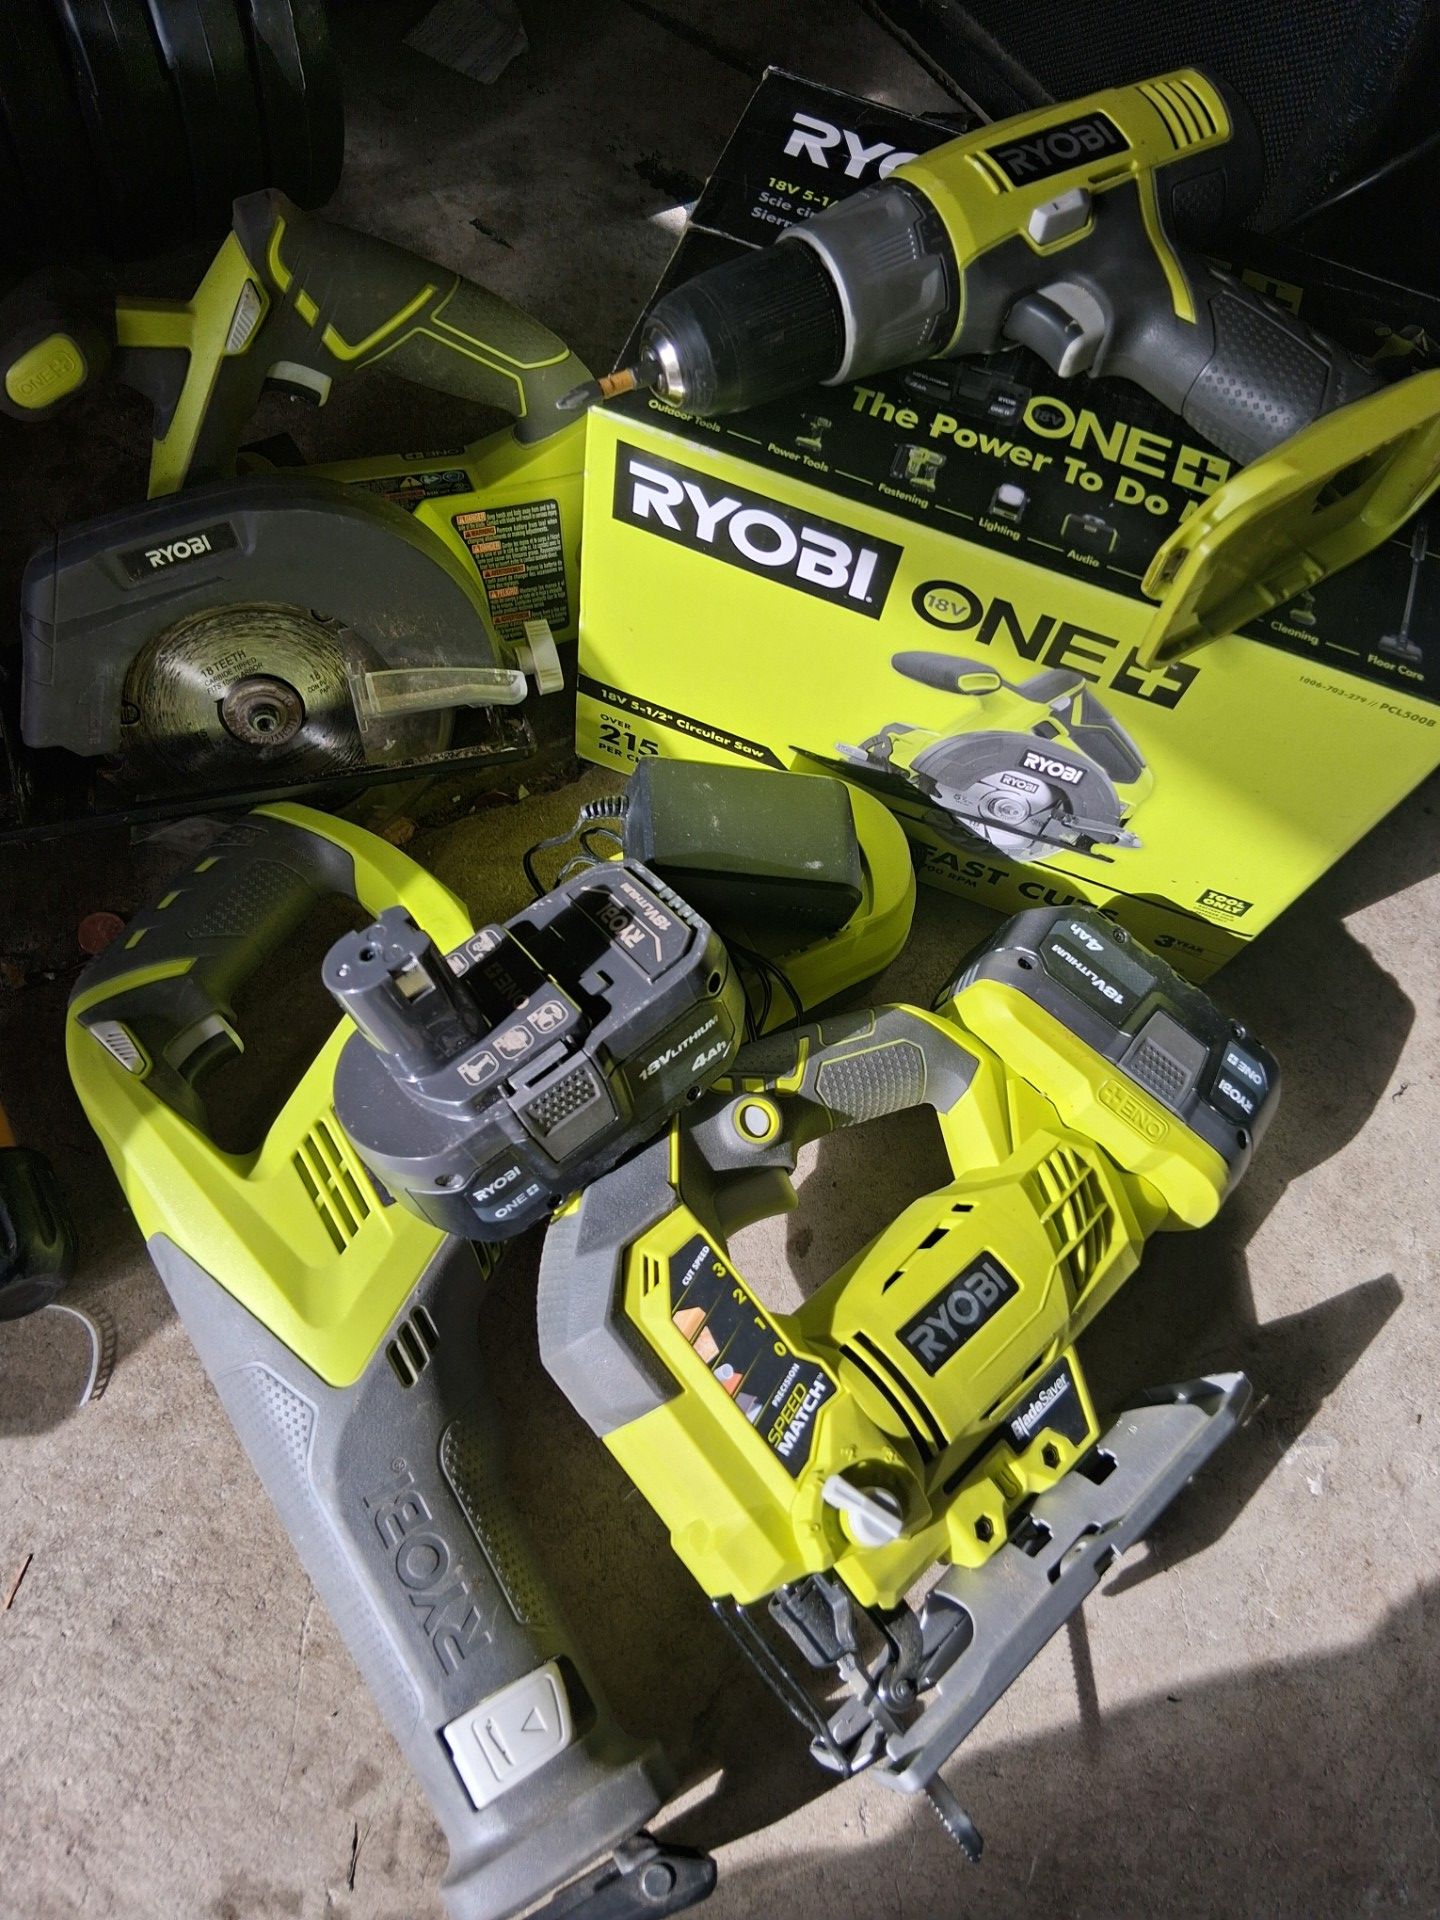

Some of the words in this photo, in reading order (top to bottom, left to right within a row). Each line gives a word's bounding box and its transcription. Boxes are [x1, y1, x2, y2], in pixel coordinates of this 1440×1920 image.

[997, 120, 1117, 176] RYOBI
[768, 177, 800, 195] 18V
[758, 191, 792, 211] Scie
[648, 399, 692, 422] Outdoor
[695, 417, 721, 433] Tools
[768, 442, 801, 462] Power
[802, 455, 829, 473] Tools
[852, 385, 919, 430] The
[929, 412, 1053, 473] Power
[1063, 456, 1104, 492] To
[1114, 475, 1169, 516] Do
[878, 481, 929, 510] Fastening
[628, 460, 879, 603] RYOBI
[978, 516, 1022, 541] Lighting
[145, 534, 212, 568] RYOBI
[1067, 549, 1100, 568] Audio
[928, 591, 970, 618] 18V
[1270, 620, 1320, 646] Cleaning
[201, 665, 214, 679] 18
[213, 650, 247, 671] TEETH
[204, 669, 233, 687] CARBIDE
[233, 656, 257, 674] TIPPED
[309, 671, 321, 682] 18
[1367, 653, 1395, 671] Floor
[1397, 665, 1425, 681] Care
[600, 713, 632, 730] OVER
[600, 688, 627, 705] 18V
[677, 719, 731, 746] Circular
[734, 741, 764, 759] Saw
[1379, 702, 1437, 728] PCL500B
[598, 743, 622, 761] PER
[599, 723, 659, 757] 215
[1023, 752, 1084, 785] RYOBI
[1002, 775, 1037, 794] RYOBI
[947, 872, 977, 888] RPM
[1203, 898, 1244, 914] ONLY
[1208, 892, 1245, 909] TOOL
[596, 903, 646, 949] RYOBI
[1153, 934, 1176, 948] 3
[1218, 1078, 1254, 1115] RYOBI
[473, 1165, 522, 1203] RYOBI
[681, 1267, 695, 1287] CUT
[693, 1245, 710, 1271] SPEED
[712, 1261, 727, 1278] 3
[732, 1287, 748, 1305] 2
[754, 1316, 767, 1331] 1
[907, 1262, 1008, 1363] RYOBI
[773, 1341, 787, 1357] 0
[771, 1363, 801, 1409] PRECISION
[767, 1382, 807, 1448] SPEED
[1011, 1372, 1070, 1441] BladeSaver
[363, 1469, 492, 1677] RYOBI
